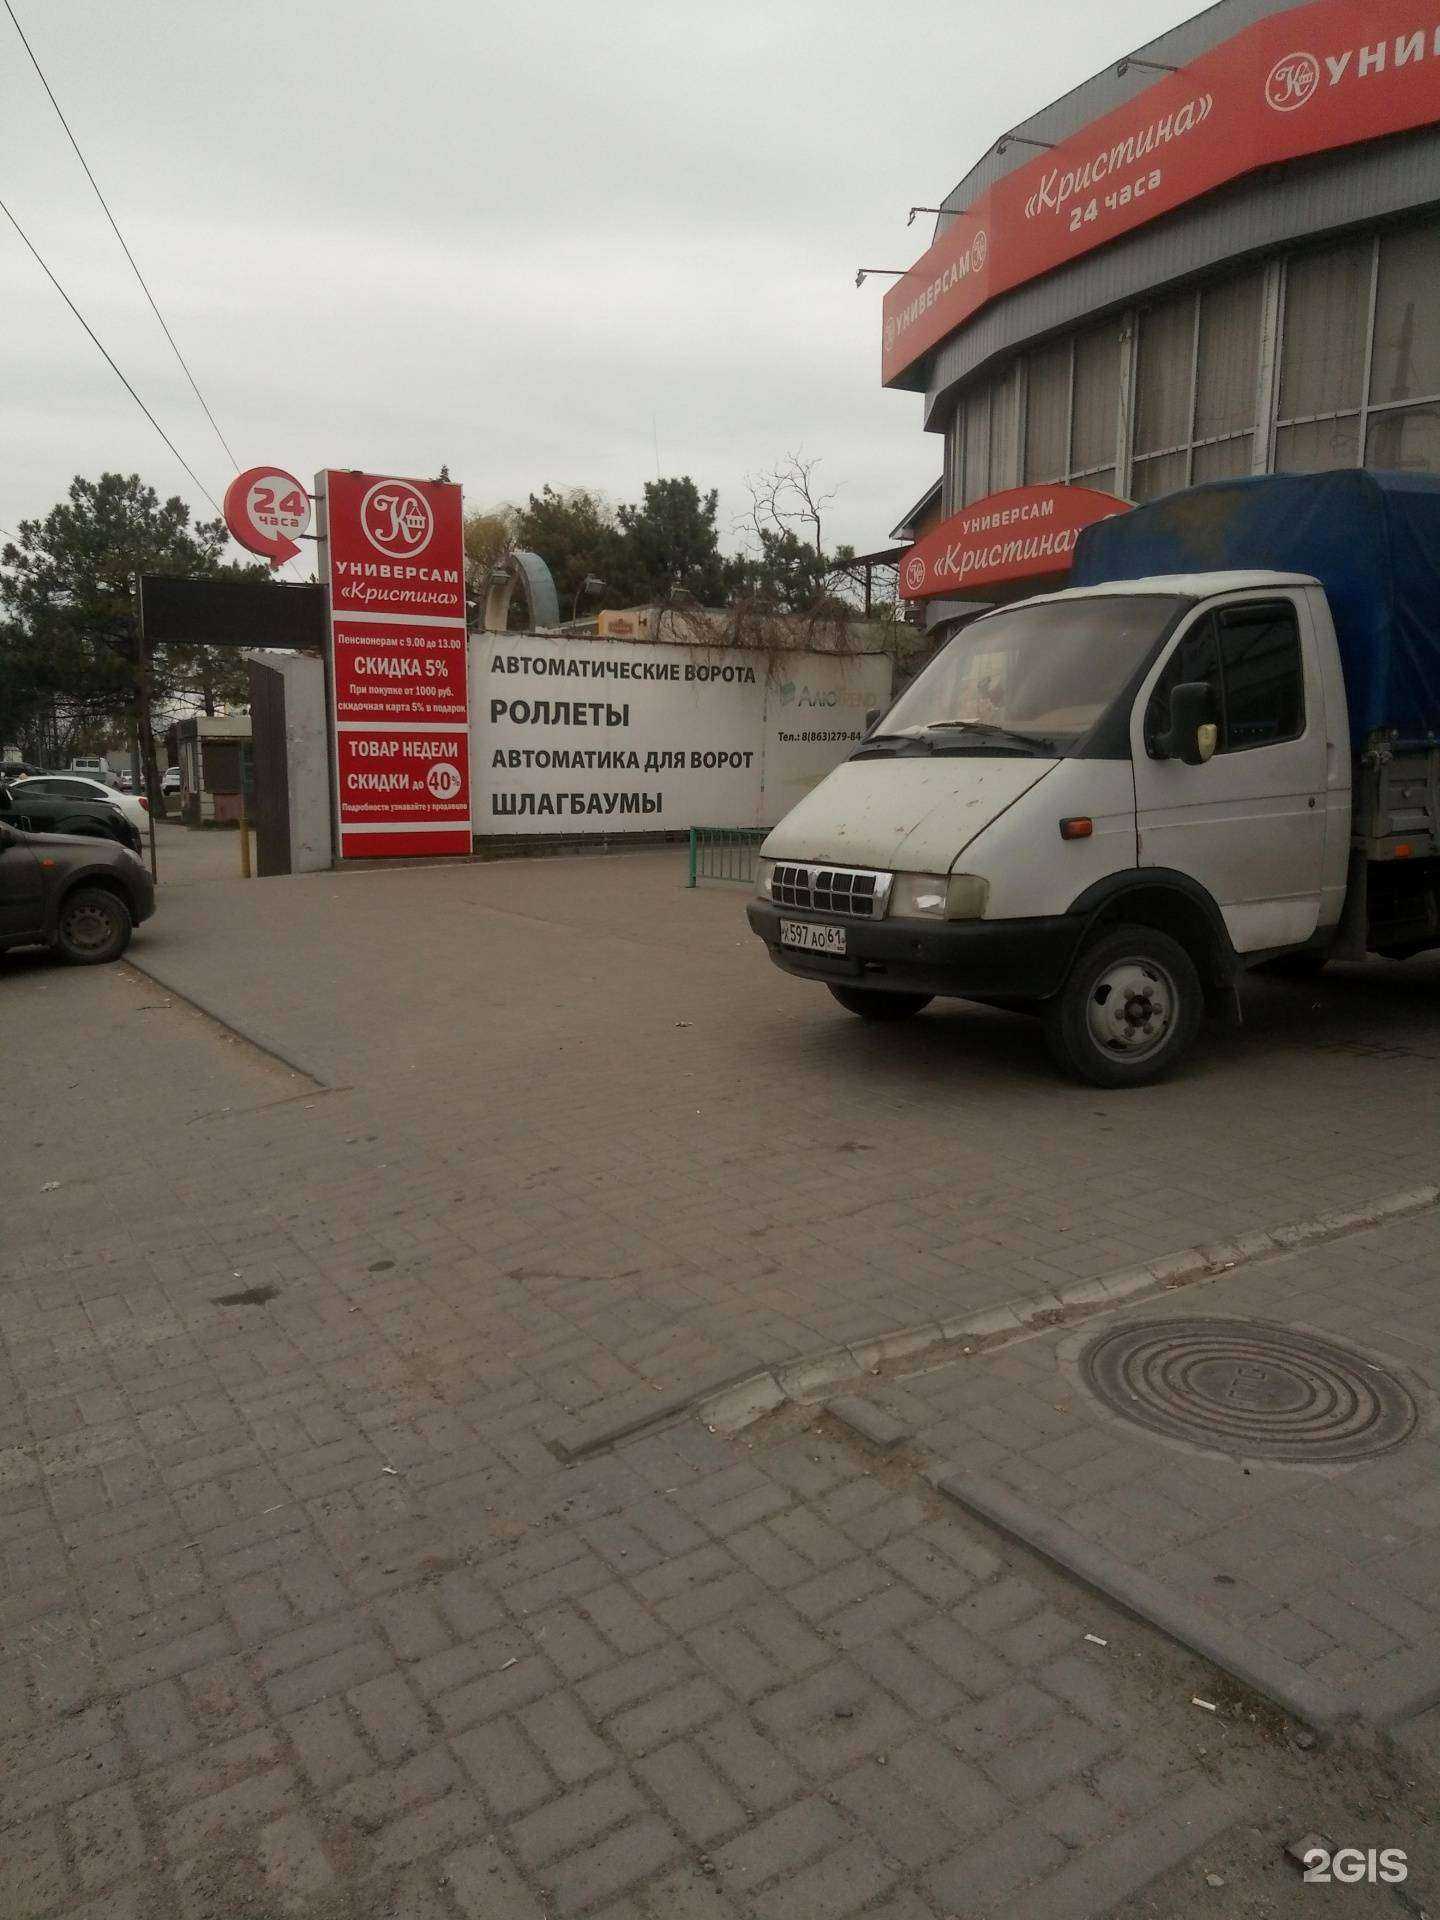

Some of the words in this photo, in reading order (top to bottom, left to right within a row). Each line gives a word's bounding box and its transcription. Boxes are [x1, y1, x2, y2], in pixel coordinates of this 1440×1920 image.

[1024, 93, 1213, 218] «Кристина»
[1069, 198, 1099, 232] 24
[1105, 168, 1161, 210] часа
[895, 249, 971, 336] УНИВЕРСАМ
[253, 487, 305, 516] 24
[259, 516, 299, 528] часа
[962, 499, 1054, 535] УНИВЕРСАМ
[336, 561, 458, 584] УНИВЕРСАМ
[341, 581, 459, 605] «Кристина»
[338, 634, 397, 647] Пенсионерам
[406, 637, 425, 648] 9.00
[426, 640, 436, 649] до
[438, 639, 461, 649] 13.00
[354, 656, 422, 678] СКИДКА
[425, 659, 449, 678] 5%
[491, 655, 681, 681] АВТОМАТИЧЕСКИЕ
[684, 664, 756, 684] ВОРОТА
[350, 684, 368, 696] При
[369, 686, 403, 697] покупке
[416, 686, 437, 697] 1000
[438, 687, 455, 699] руб.
[338, 701, 384, 712] скидочная
[386, 703, 411, 714] карта
[412, 702, 425, 713] 5%
[433, 703, 466, 714] подарок
[490, 699, 630, 727] РОЛЛЕТЫ
[349, 741, 400, 757] ТОВАР
[402, 741, 459, 760] НЕДЕЛИ
[492, 749, 640, 769] АВТОМАТИКА
[644, 751, 686, 773] ДЛЯ
[690, 751, 754, 769] ВОРОТ
[347, 774, 410, 792] СКИДКИ
[412, 780, 425, 791] до
[428, 771, 460, 791] 40%
[342, 802, 390, 813] Подробности
[492, 792, 662, 816] ШЛАГБАУМЫ
